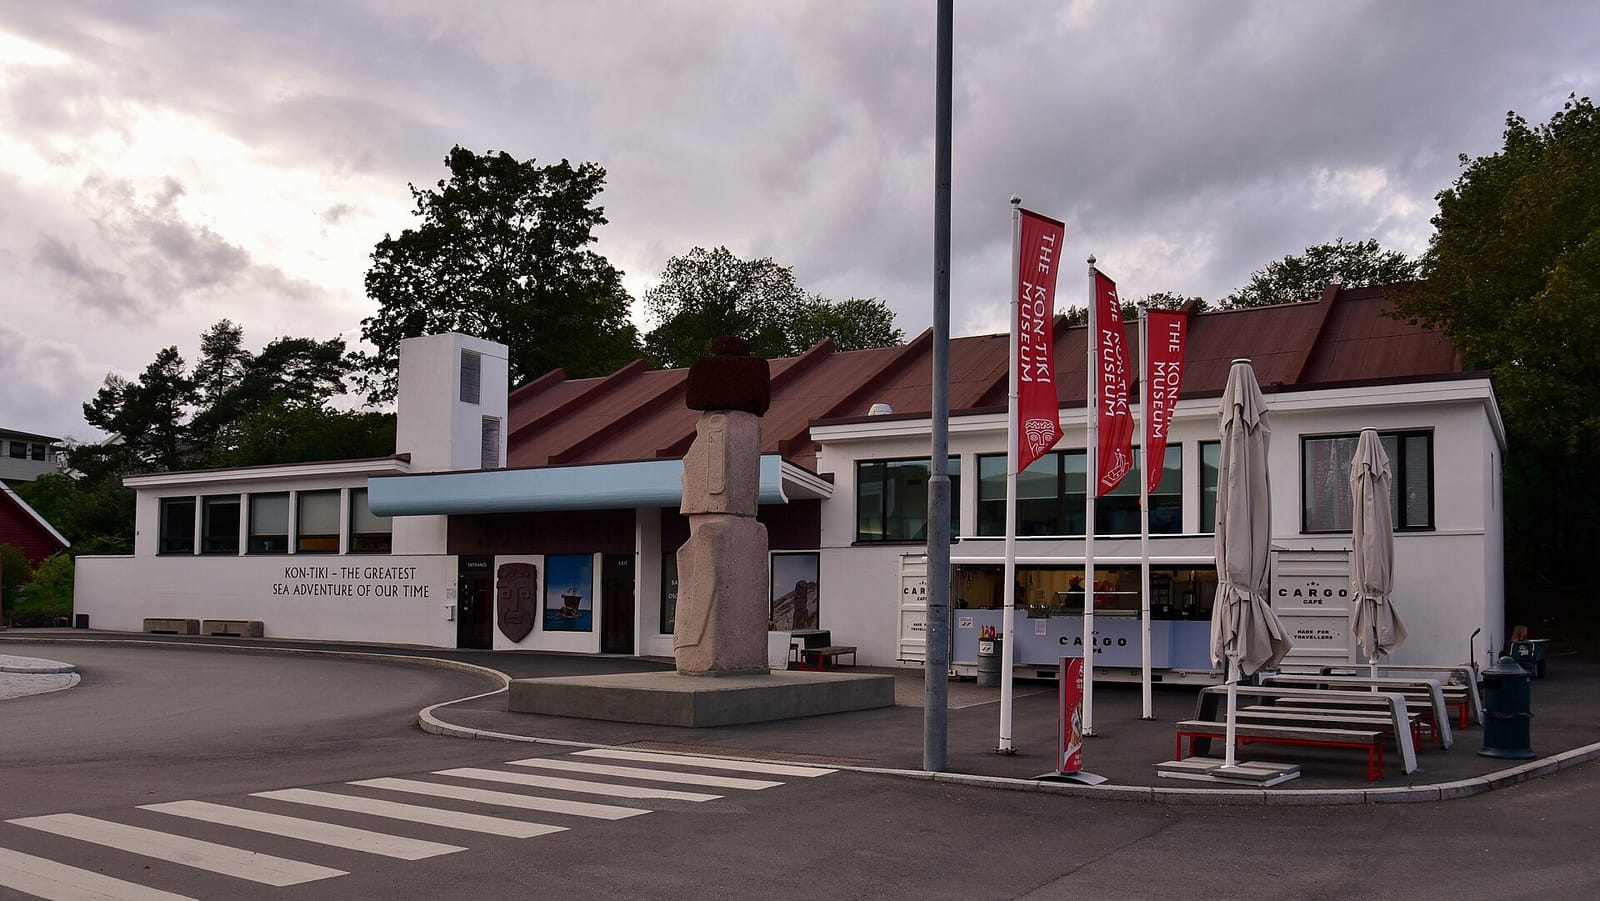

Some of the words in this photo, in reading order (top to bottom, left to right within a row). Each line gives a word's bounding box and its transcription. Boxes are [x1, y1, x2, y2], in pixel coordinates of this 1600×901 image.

[1038, 233, 1056, 275] THE
[1107, 290, 1118, 322] THE
[1021, 281, 1033, 383] MUSEUM
[1033, 286, 1051, 384] KON-TIKI
[1168, 321, 1181, 353] THE
[1102, 329, 1116, 417] MUSEUM
[1152, 361, 1166, 438] MUSEUM
[284, 566, 328, 579] KON-TIKI
[341, 567, 360, 579] THE
[364, 567, 416, 580] GREATEST
[272, 583, 290, 595] SEA
[293, 584, 353, 597] ADVENTURE
[357, 584, 371, 597] OF
[375, 585, 398, 597] OUR
[403, 585, 429, 598] TIME
[903, 587, 926, 595] CAR
[1278, 588, 1348, 597] CARGO
